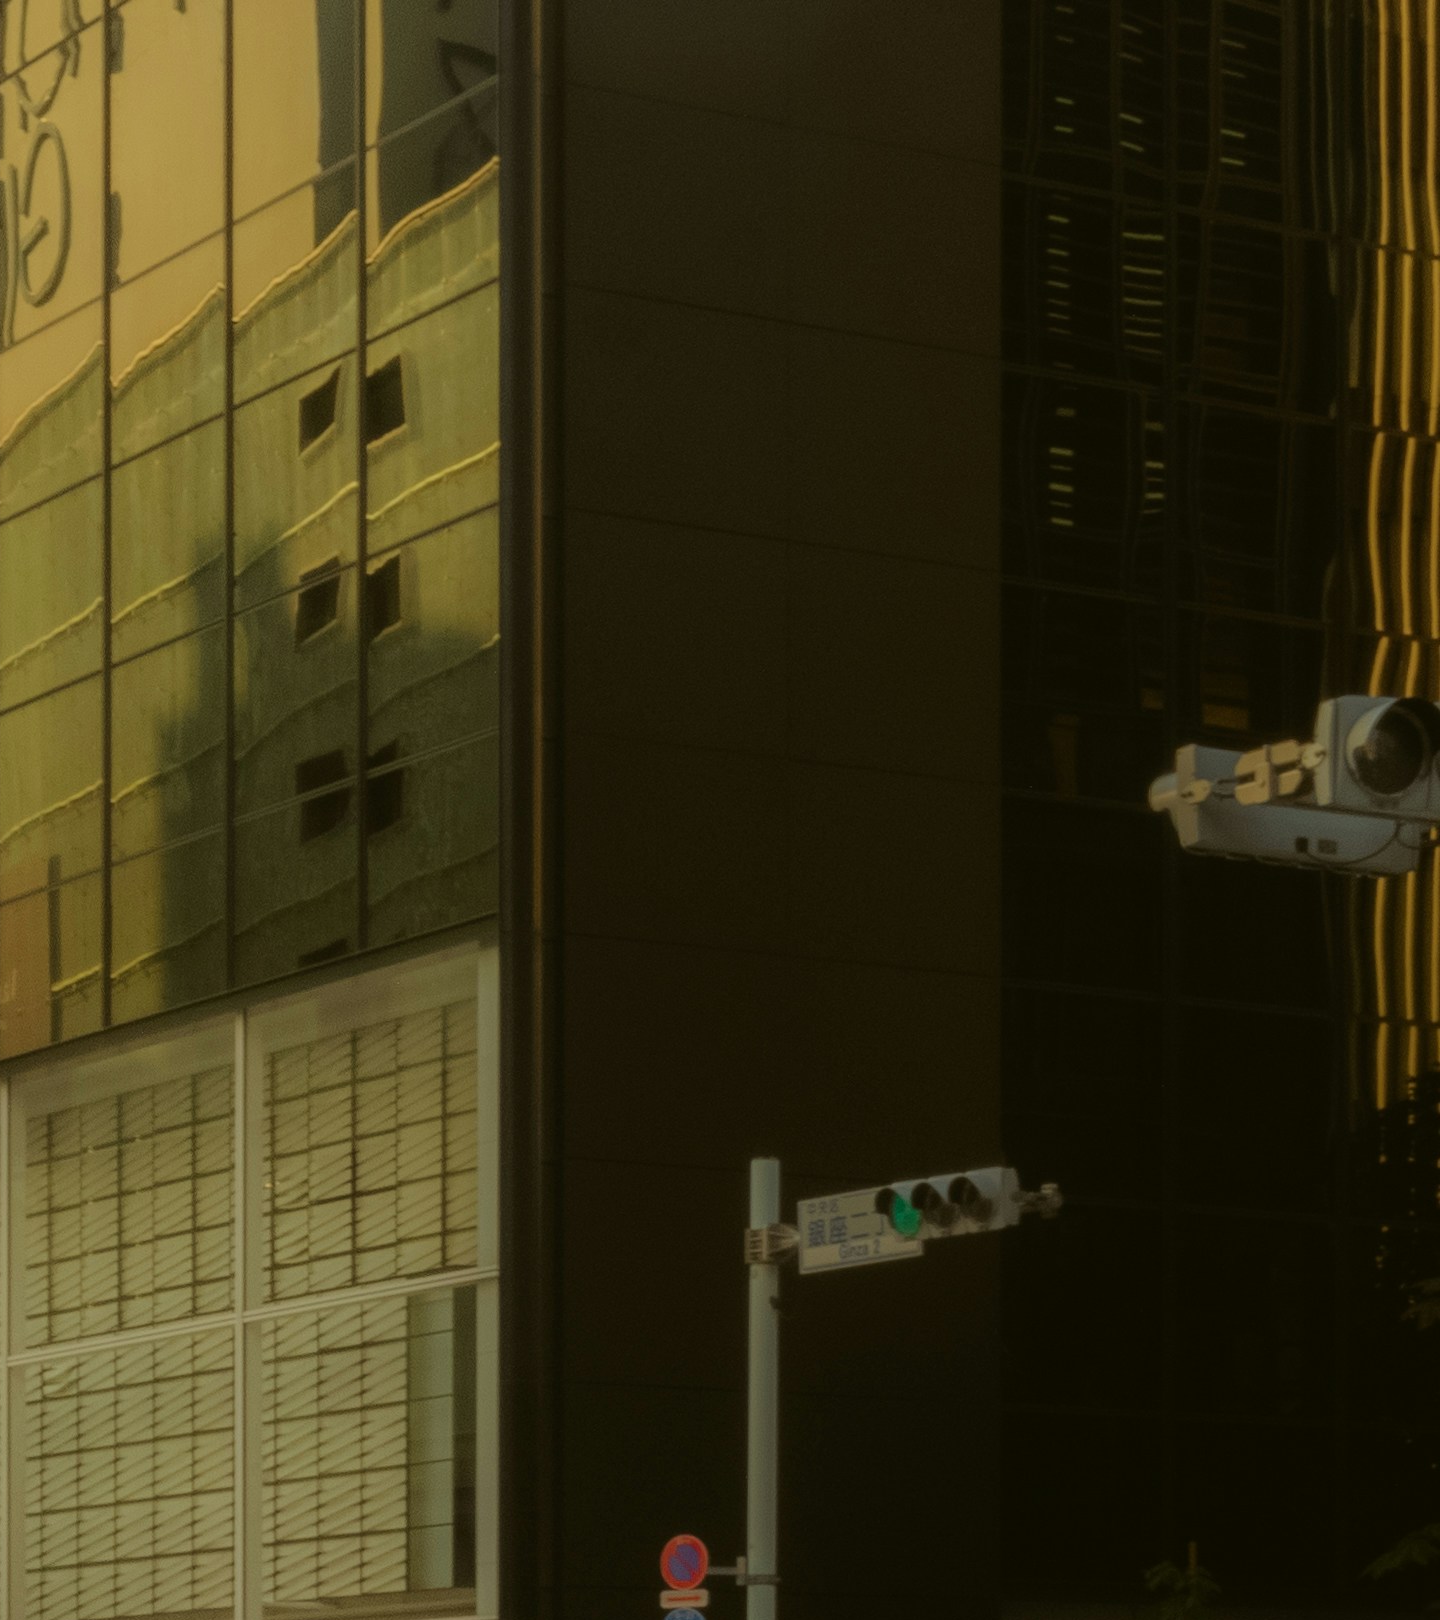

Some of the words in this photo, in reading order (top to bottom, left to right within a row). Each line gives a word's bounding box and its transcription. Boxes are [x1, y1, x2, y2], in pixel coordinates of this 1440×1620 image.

[807, 1198, 839, 1215] 中央区
[839, 1241, 869, 1259] Ginza
[872, 1238, 881, 1254] 2
